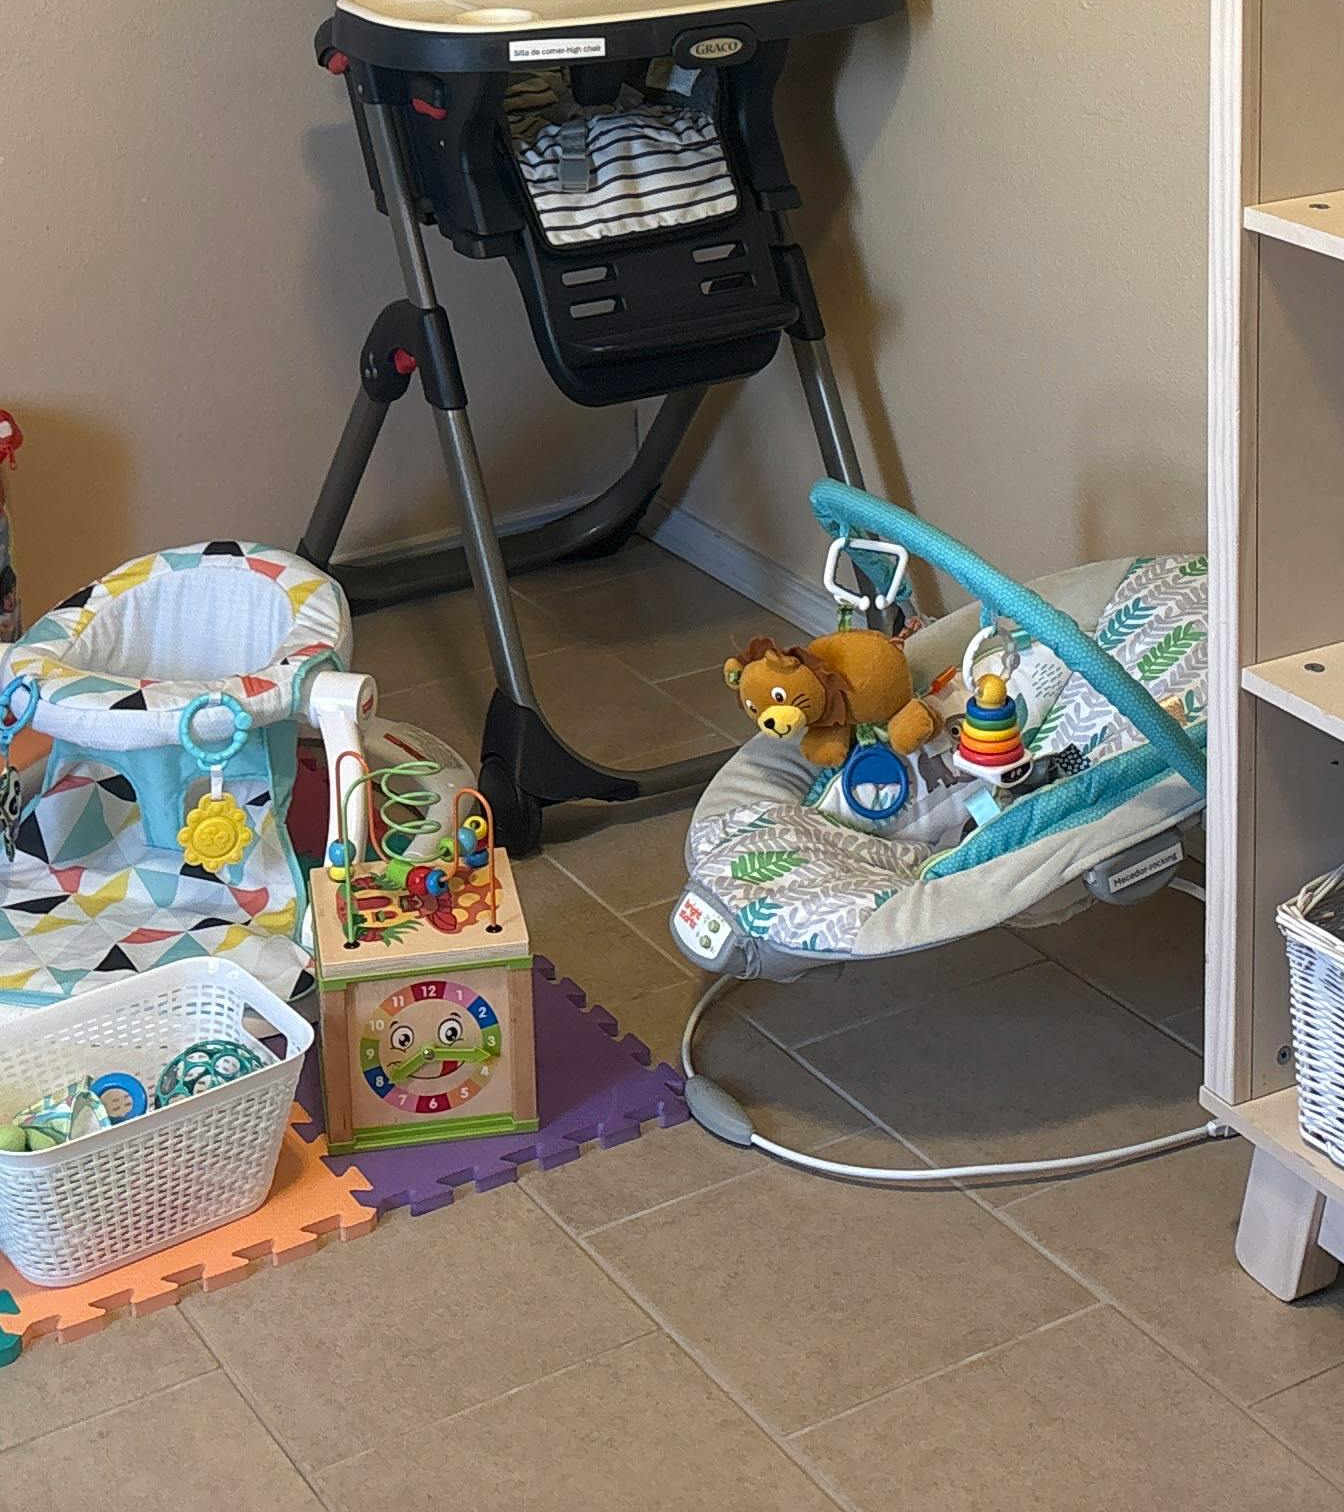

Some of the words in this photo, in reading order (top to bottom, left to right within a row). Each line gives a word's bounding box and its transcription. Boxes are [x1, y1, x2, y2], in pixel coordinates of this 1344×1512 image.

[695, 42, 738, 55] GRACO
[421, 985, 437, 997] 12
[456, 990, 463, 1001] 1
[392, 996, 404, 1008] 11
[478, 1006, 488, 1018] 2
[369, 1020, 384, 1031] 10
[488, 1035, 496, 1046] 3
[366, 1048, 374, 1060] 9
[480, 1066, 490, 1077] 4
[376, 1076, 384, 1087] 8
[460, 1087, 469, 1098] 5
[398, 1094, 407, 1106] 7
[428, 1098, 438, 1110] 6
